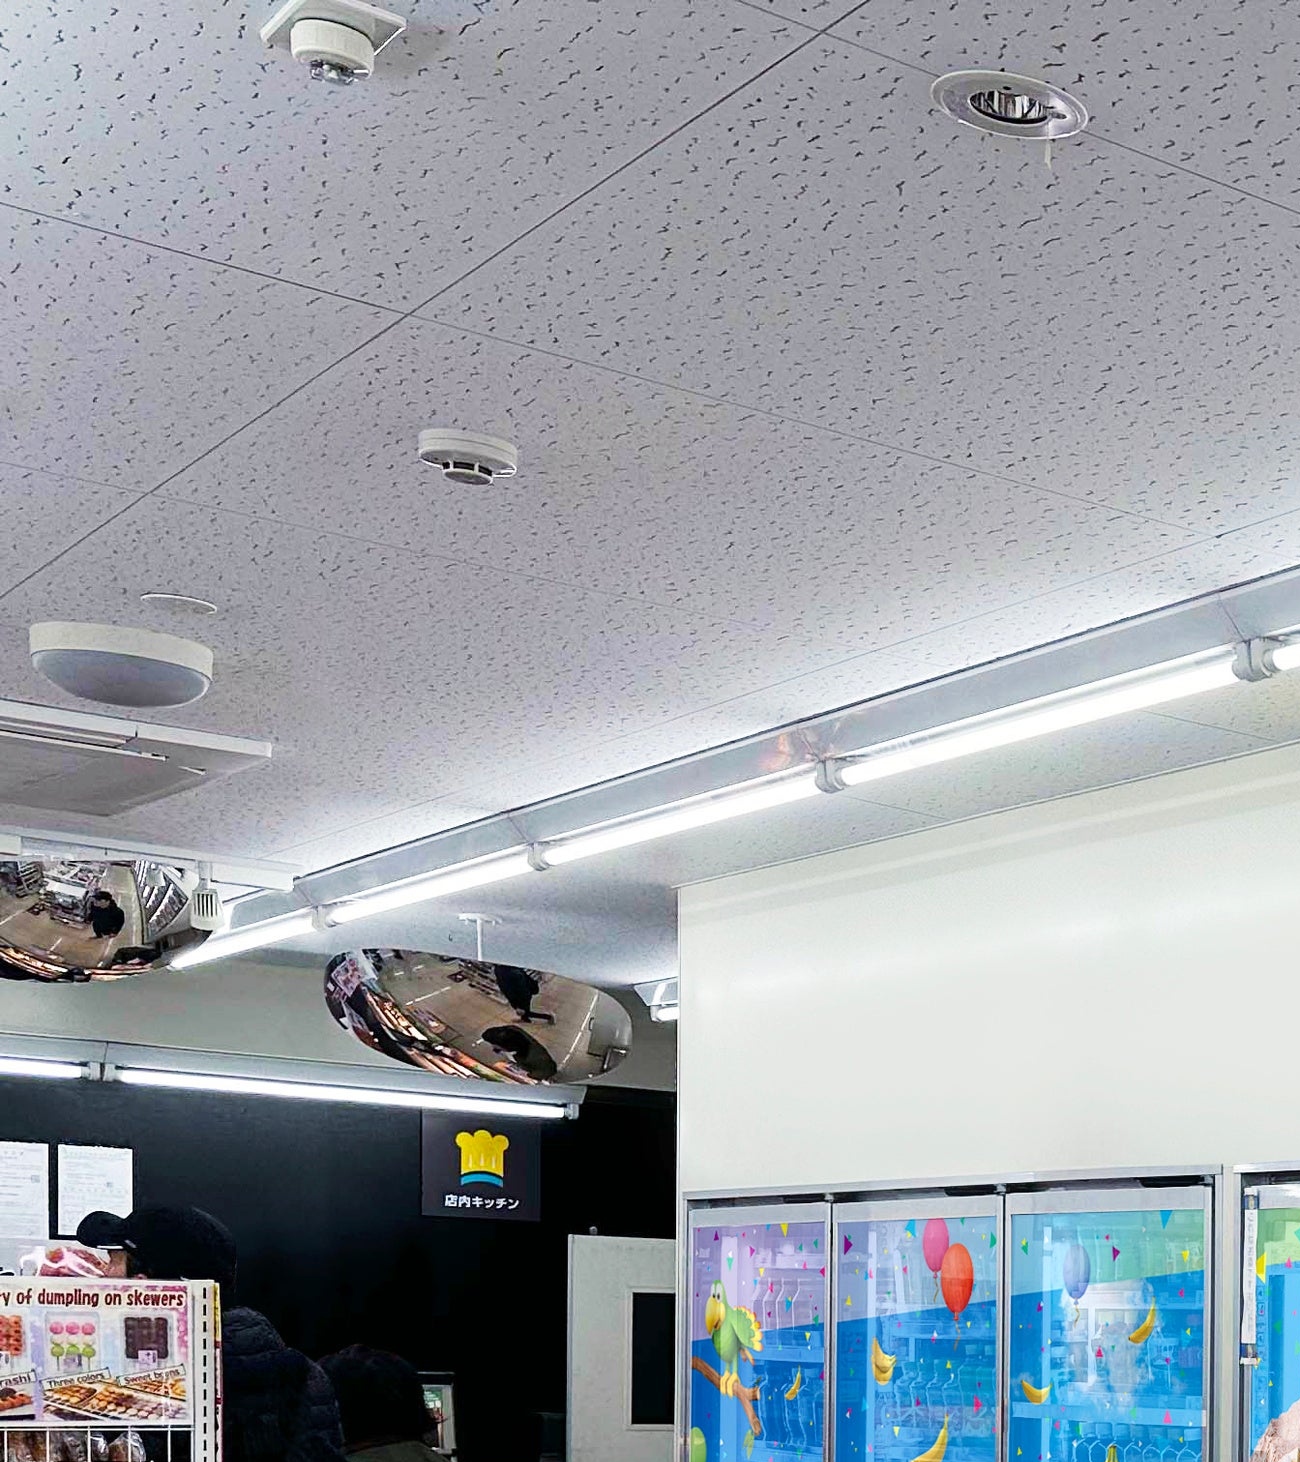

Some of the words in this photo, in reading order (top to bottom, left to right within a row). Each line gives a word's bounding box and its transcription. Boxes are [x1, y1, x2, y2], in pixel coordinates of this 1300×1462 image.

[444, 1194, 520, 1209] 店内キッチン
[17, 1288, 33, 1305] of
[38, 1289, 99, 1307] dumpling
[104, 1292, 122, 1306] on
[126, 1290, 184, 1306] skewers
[47, 1378, 76, 1389] Three
[77, 1371, 105, 1384] colors
[124, 1373, 151, 1385] Sweet
